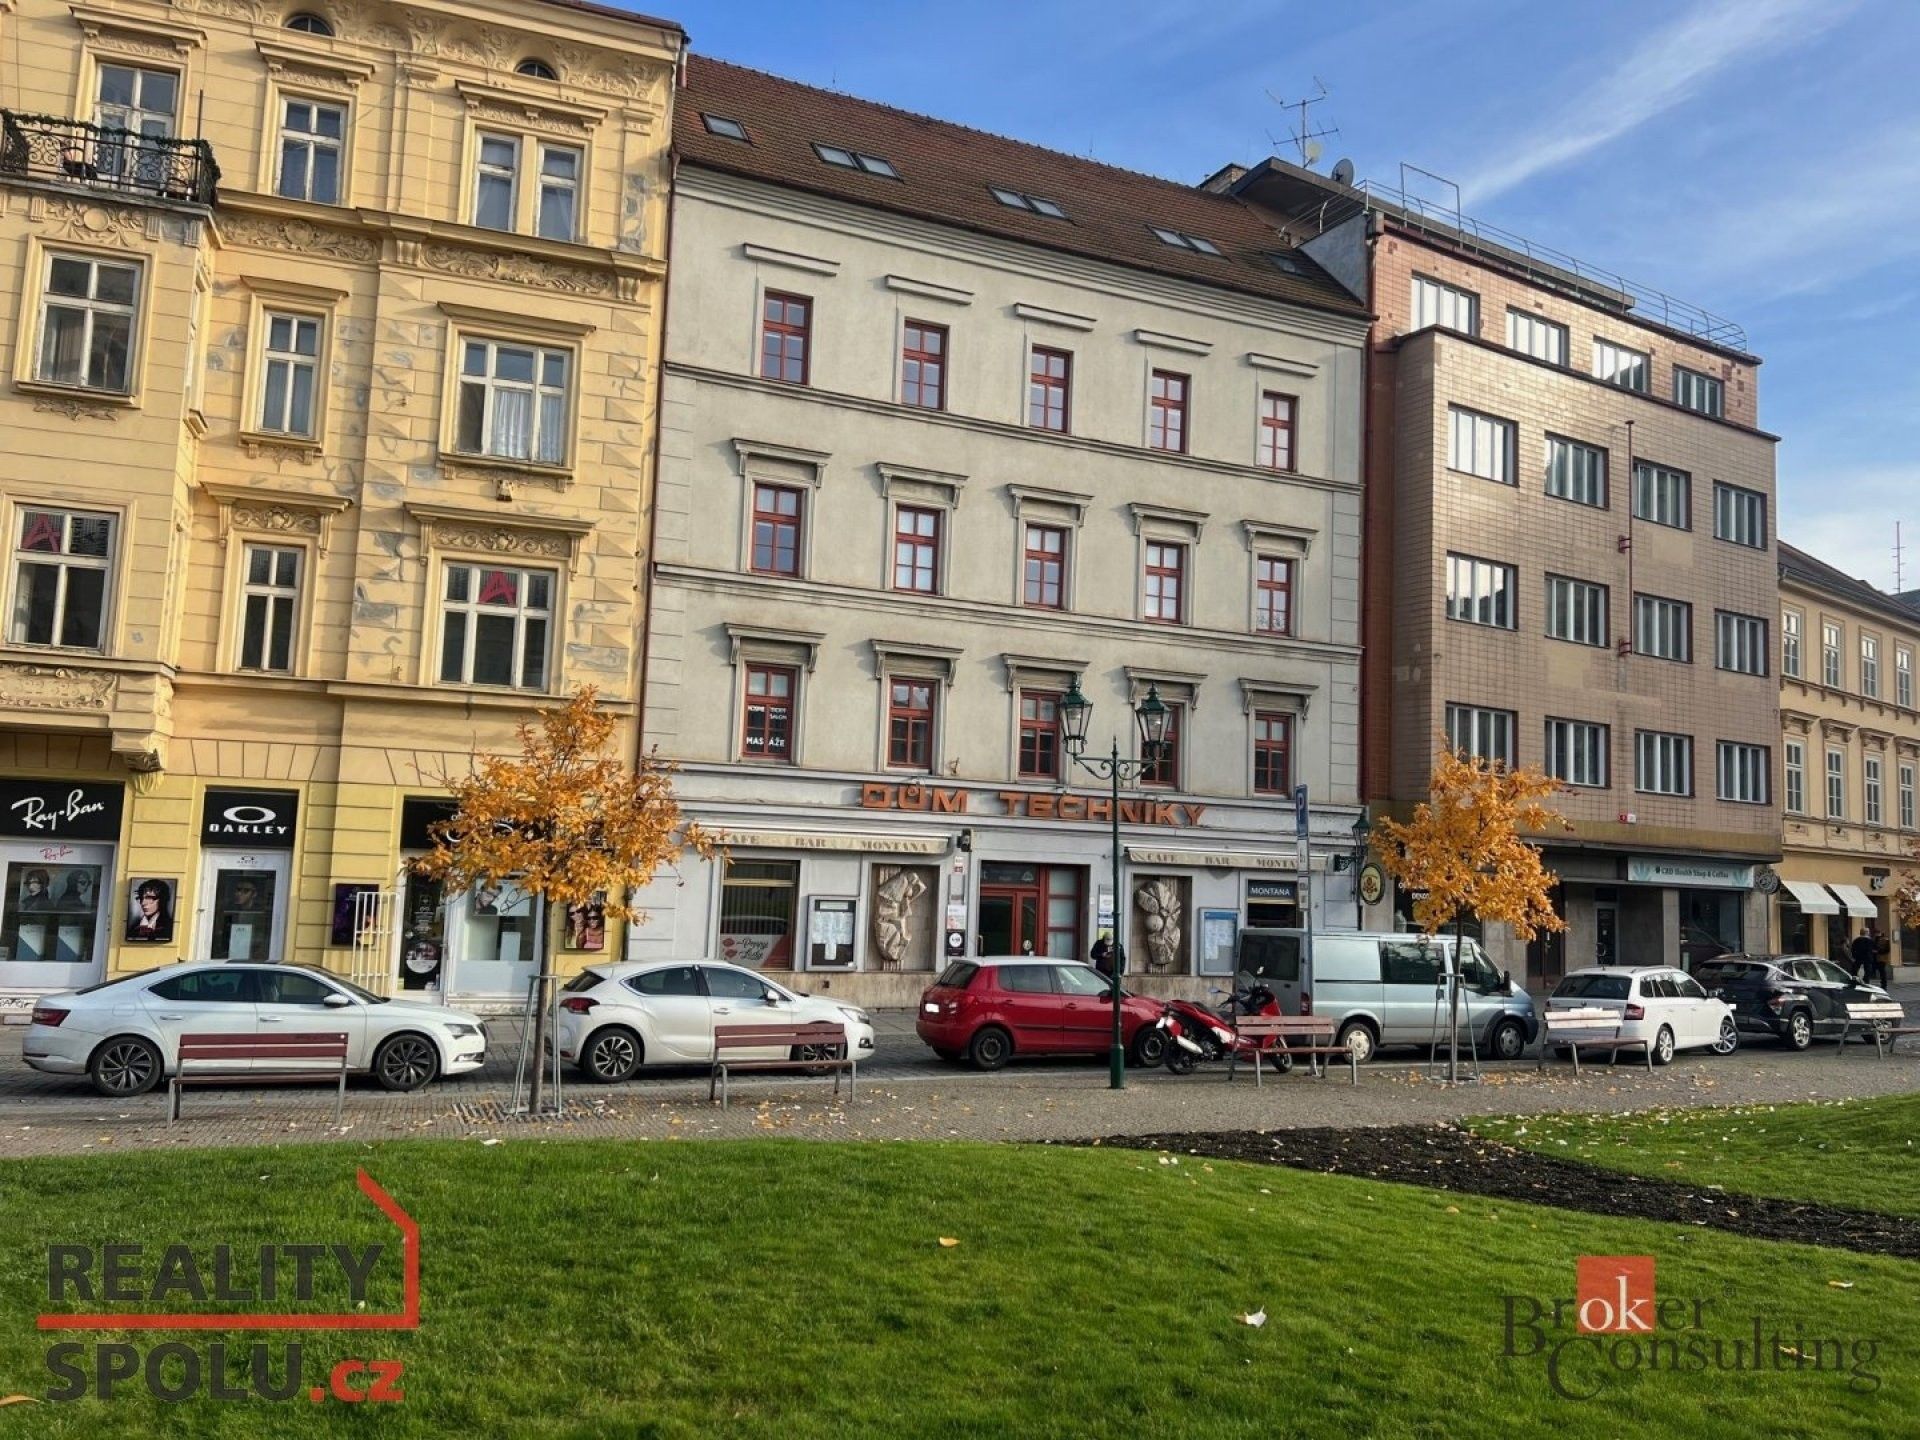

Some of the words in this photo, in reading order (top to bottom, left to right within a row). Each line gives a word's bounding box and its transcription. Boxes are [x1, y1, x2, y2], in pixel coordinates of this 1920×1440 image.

[11, 789, 105, 831] Ray-Ban
[863, 783, 967, 812] DŮM
[1000, 792, 1206, 826] TECHNIKY
[209, 823, 287, 835] OAKLEY
[795, 837, 826, 848] BAR
[861, 840, 928, 851] MONTANA
[1205, 856, 1230, 865] BAR
[1256, 858, 1297, 868] MONTA
[1251, 886, 1291, 896] MONTANA
